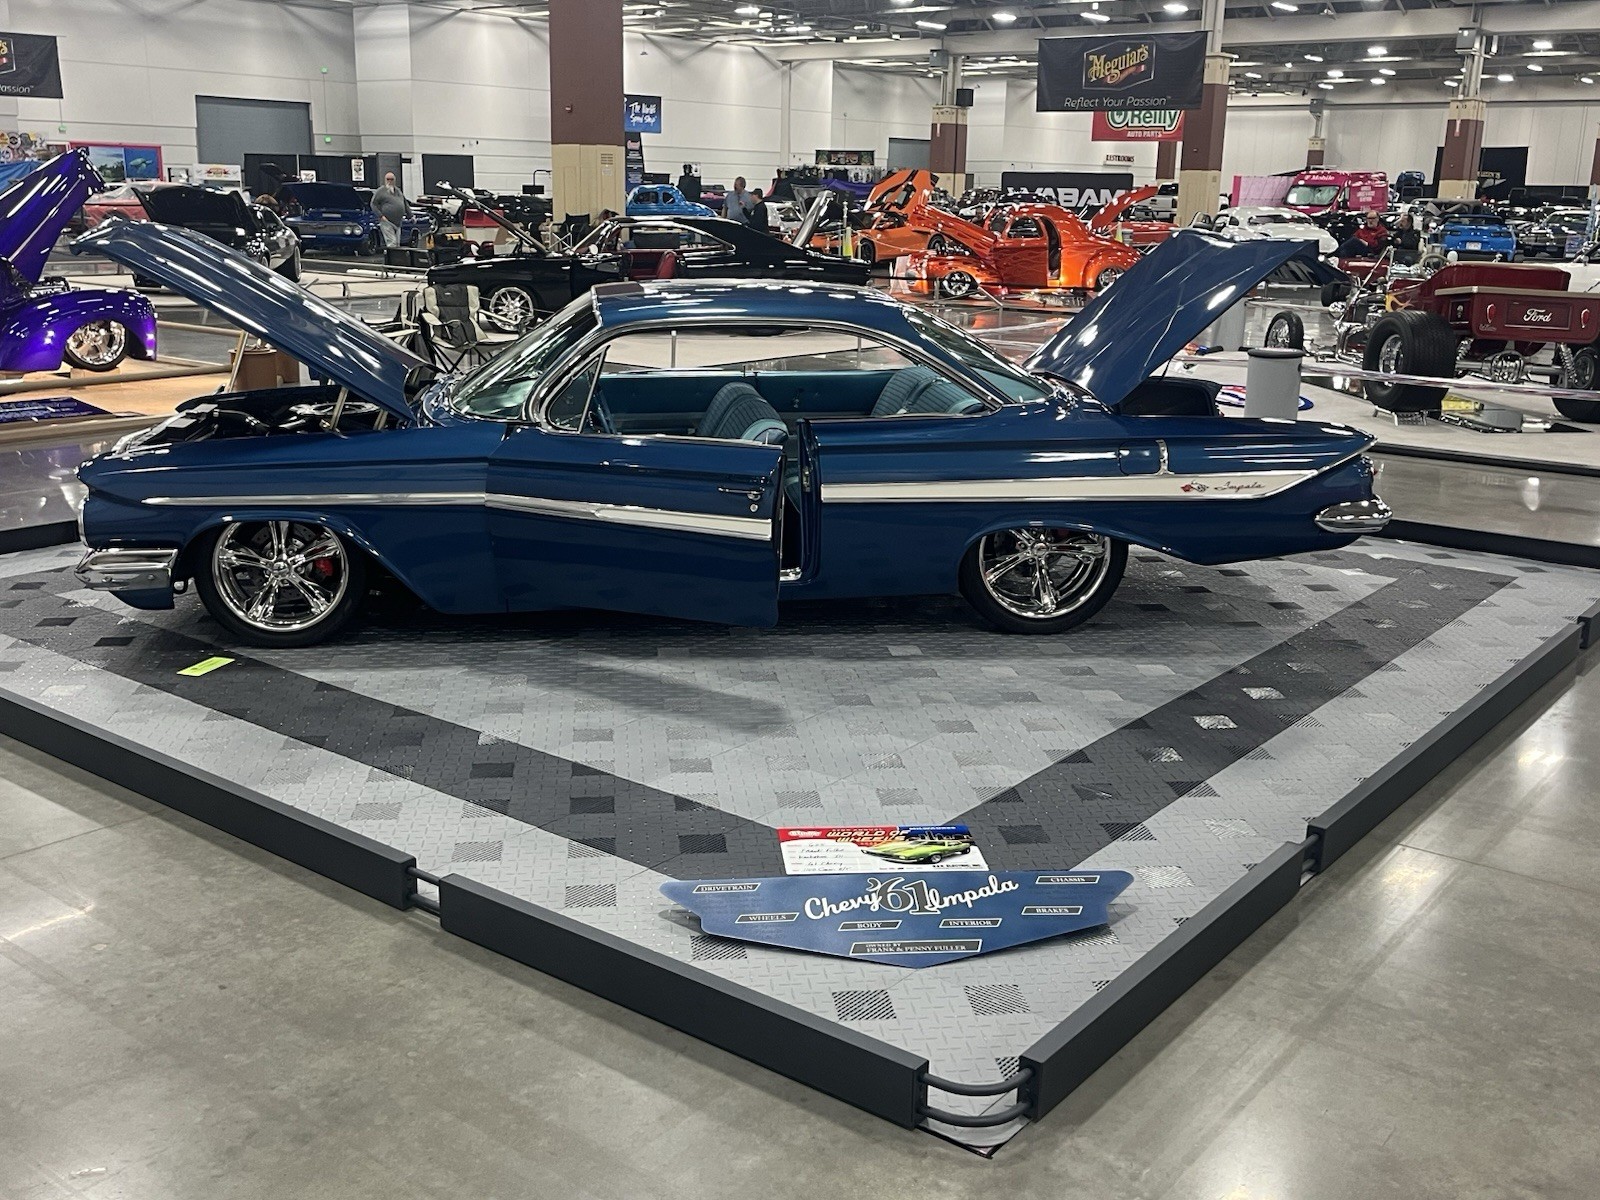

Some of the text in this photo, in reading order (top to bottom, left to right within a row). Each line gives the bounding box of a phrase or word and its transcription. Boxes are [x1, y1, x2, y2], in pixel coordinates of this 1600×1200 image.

[1088, 44, 1149, 84] Meguiar's
[1064, 96, 1099, 109] Reflect
[1102, 97, 1124, 107] Your
[1127, 130, 1162, 138] AUTO PARTS
[1106, 154, 1134, 162] RESTROOMS
[1523, 308, 1553, 322] Ford
[1214, 481, 1265, 493] Impala
[889, 829, 911, 837] OF
[804, 892, 883, 920] Chevy
[924, 874, 1019, 912] Impala
[948, 919, 992, 927] INTERIOR
